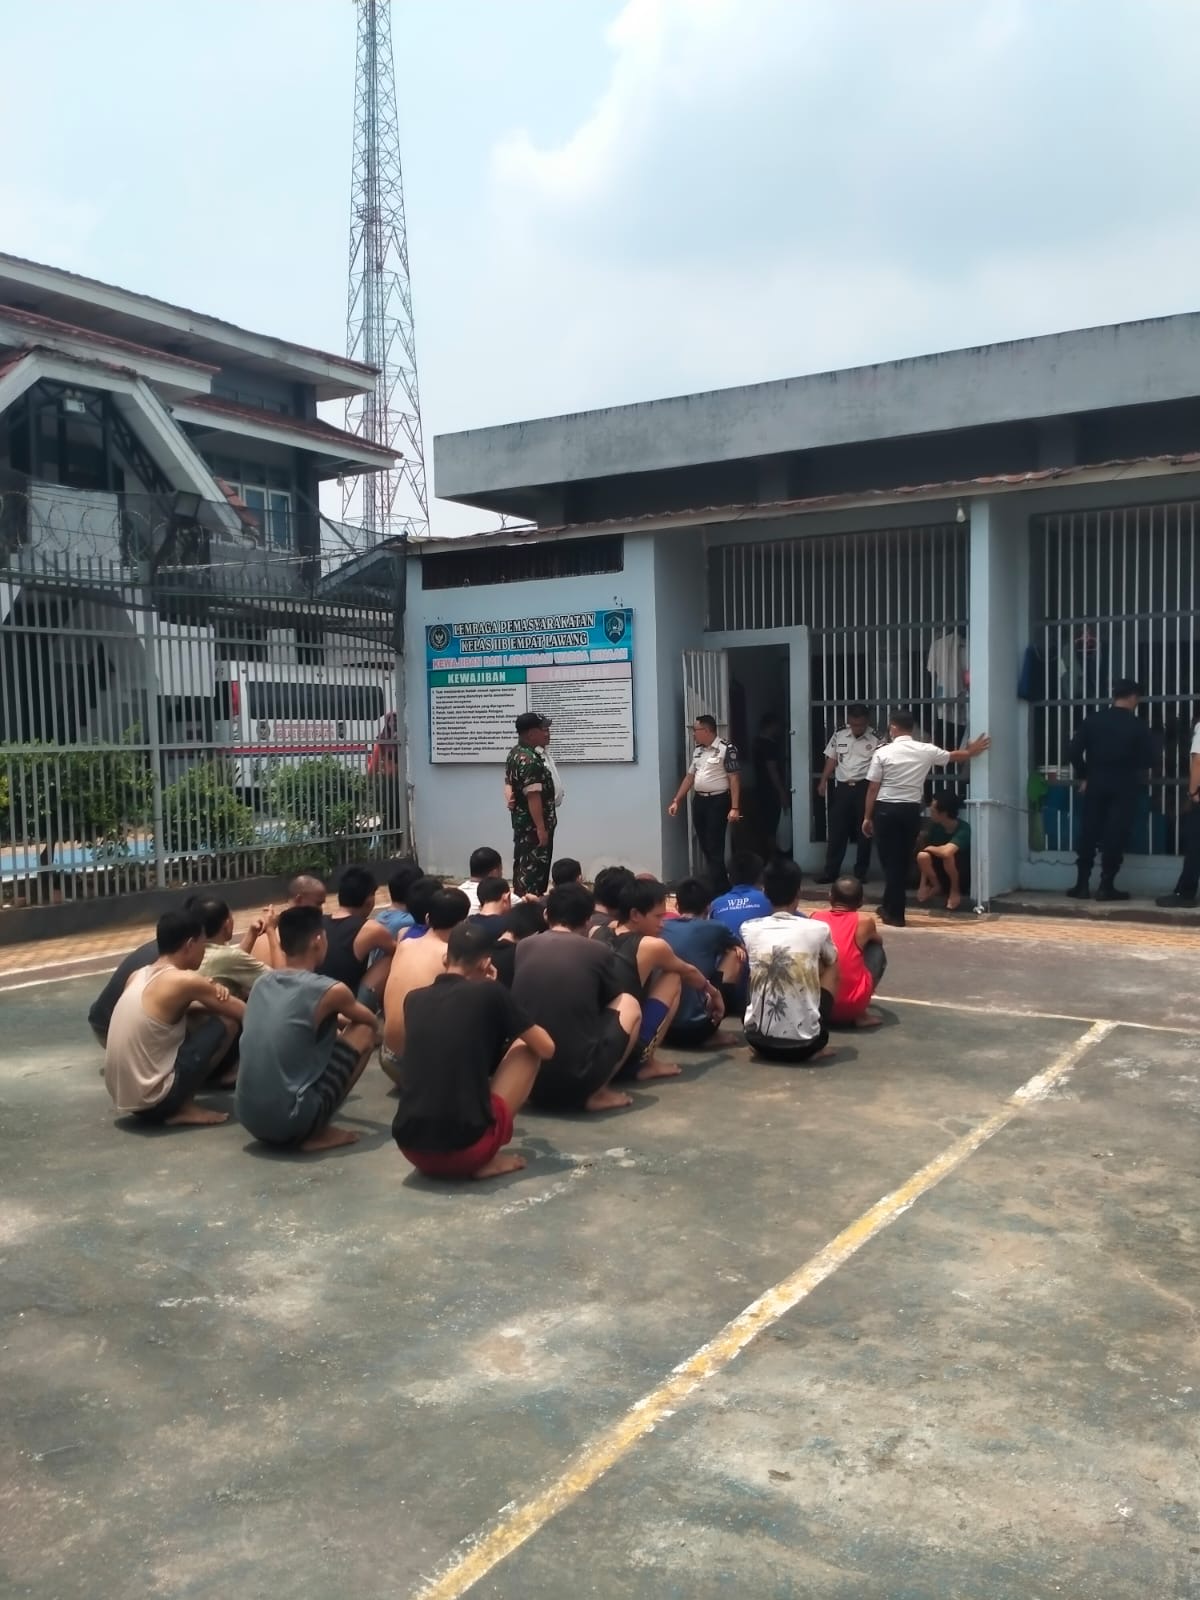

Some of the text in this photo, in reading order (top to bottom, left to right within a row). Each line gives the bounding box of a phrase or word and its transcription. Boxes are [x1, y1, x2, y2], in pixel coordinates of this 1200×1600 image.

[454, 614, 595, 636] LEMBAGA PEMASYARAKATAN
[461, 632, 588, 652] KELAS IIB EMPAT LAWANG
[433, 657, 482, 670] KEWAJIBAN
[447, 671, 506, 684] KEWAJIBAN
